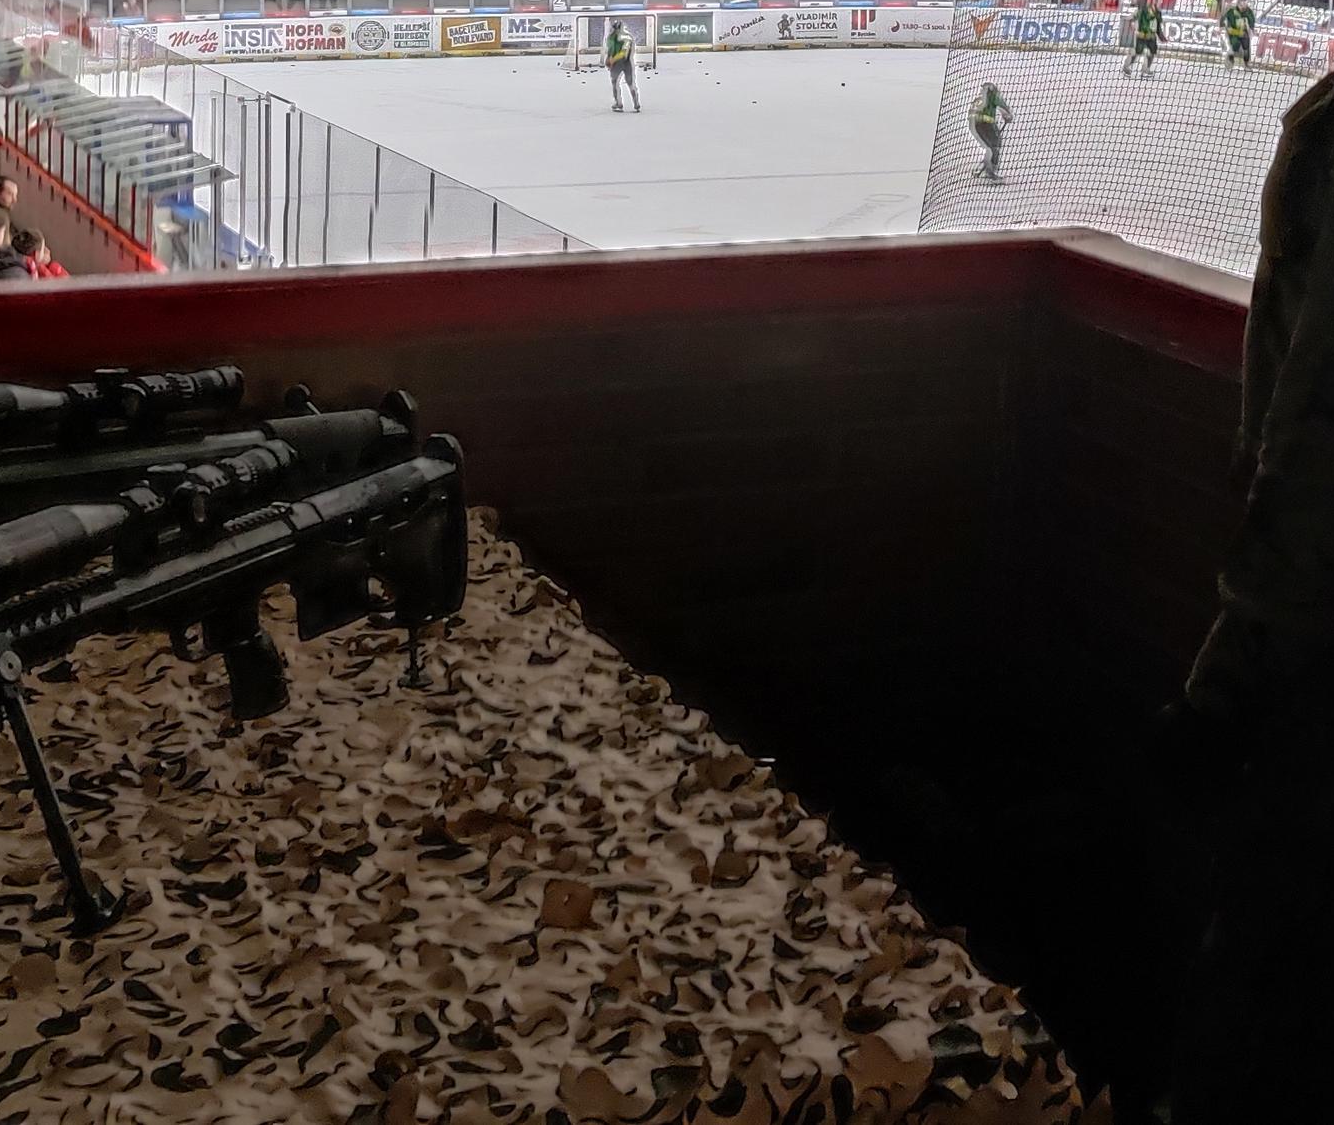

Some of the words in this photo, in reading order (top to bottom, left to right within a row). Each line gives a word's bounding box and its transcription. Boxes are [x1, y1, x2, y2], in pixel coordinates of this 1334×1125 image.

[285, 24, 324, 37] HOFA
[1000, 13, 1114, 44] Tipsport
[285, 37, 346, 51] HOFMAN
[453, 32, 495, 46] BOULEVARD
